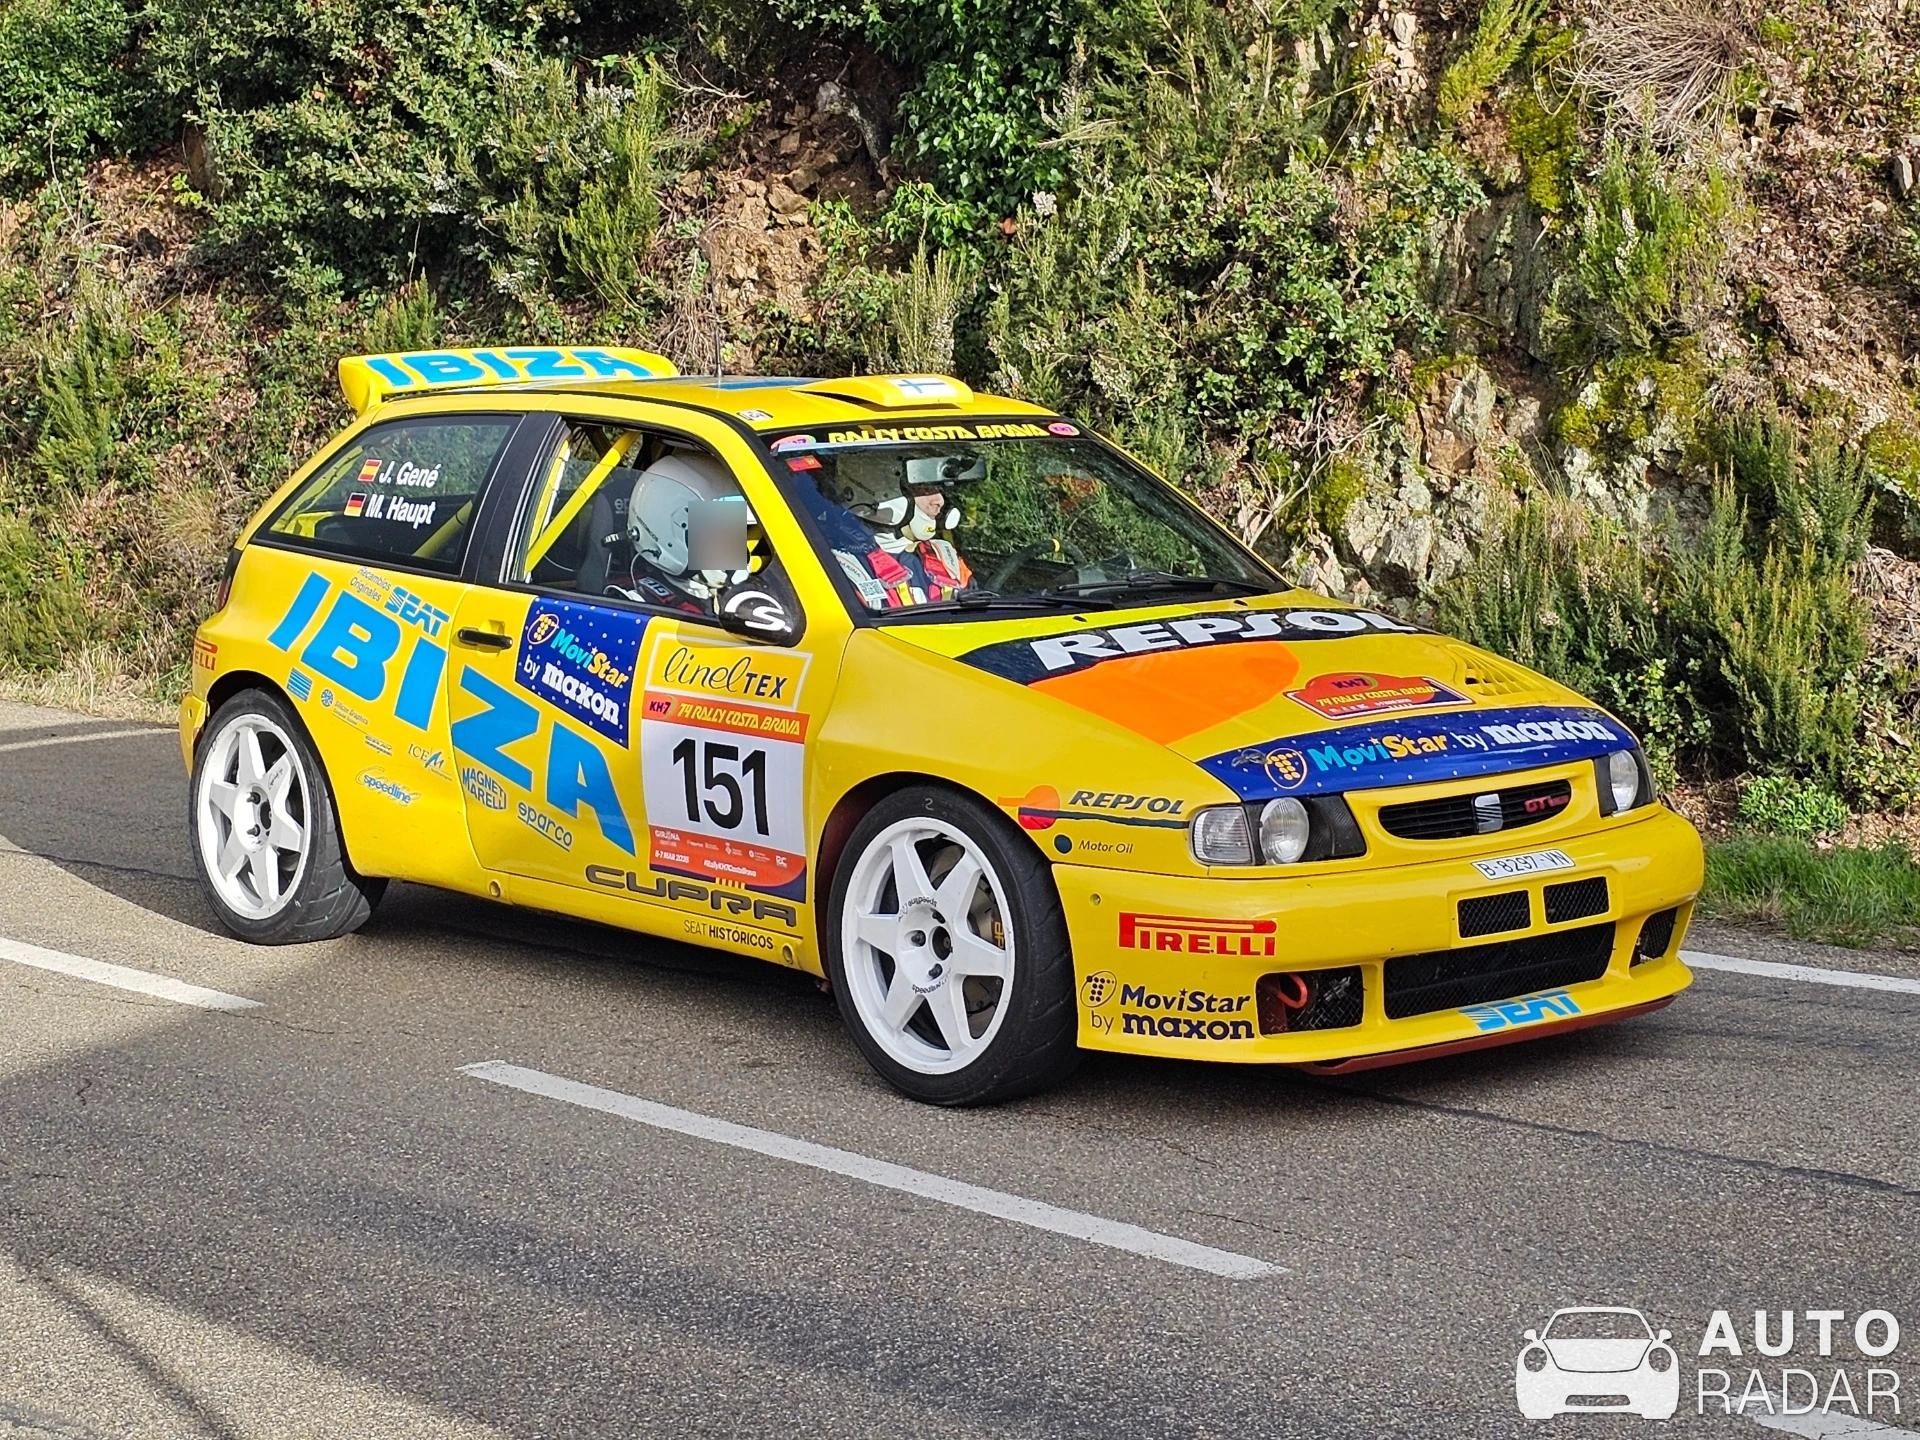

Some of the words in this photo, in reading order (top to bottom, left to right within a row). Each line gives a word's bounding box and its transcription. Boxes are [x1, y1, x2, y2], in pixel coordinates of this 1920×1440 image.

[366, 350, 655, 387] IBIZA
[828, 427, 900, 444] RALLY
[902, 426, 977, 441] COSTA
[975, 423, 1051, 439] BRAVA
[378, 460, 395, 484] J.
[396, 461, 442, 489] Gené
[364, 493, 383, 519] M.
[385, 495, 437, 530] Haupt
[350, 576, 382, 602] Originales
[384, 586, 450, 638] SEAT
[551, 627, 629, 689] MoviStar
[1030, 610, 1418, 671] REPSOL
[523, 654, 542, 681] by
[542, 663, 621, 726] maxon
[267, 571, 637, 857] IBIZA
[677, 702, 692, 718] 74
[692, 704, 725, 724] RALLY
[725, 711, 761, 729] COSTA
[763, 716, 801, 736] BRAVA
[1307, 734, 1448, 772] MoviStar
[1451, 730, 1487, 751] by
[1484, 718, 1618, 745] maxon
[363, 774, 411, 804] speedline
[462, 780, 507, 810] MARELLI
[672, 737, 771, 837] 151
[1068, 790, 1186, 815] REPSOL
[518, 802, 573, 848] sparco
[1078, 839, 1112, 854] Motor
[1113, 841, 1134, 855] Oil
[586, 864, 797, 928] CUPRA
[683, 919, 709, 937] SEAT
[708, 921, 774, 950] HISTÓRICOS
[1119, 912, 1278, 957] PIRELLI
[1119, 987, 1252, 1014] MoviStar
[1458, 989, 1582, 1032] SEAT
[1089, 1009, 1114, 1036] by
[1122, 1011, 1256, 1041] maxon
